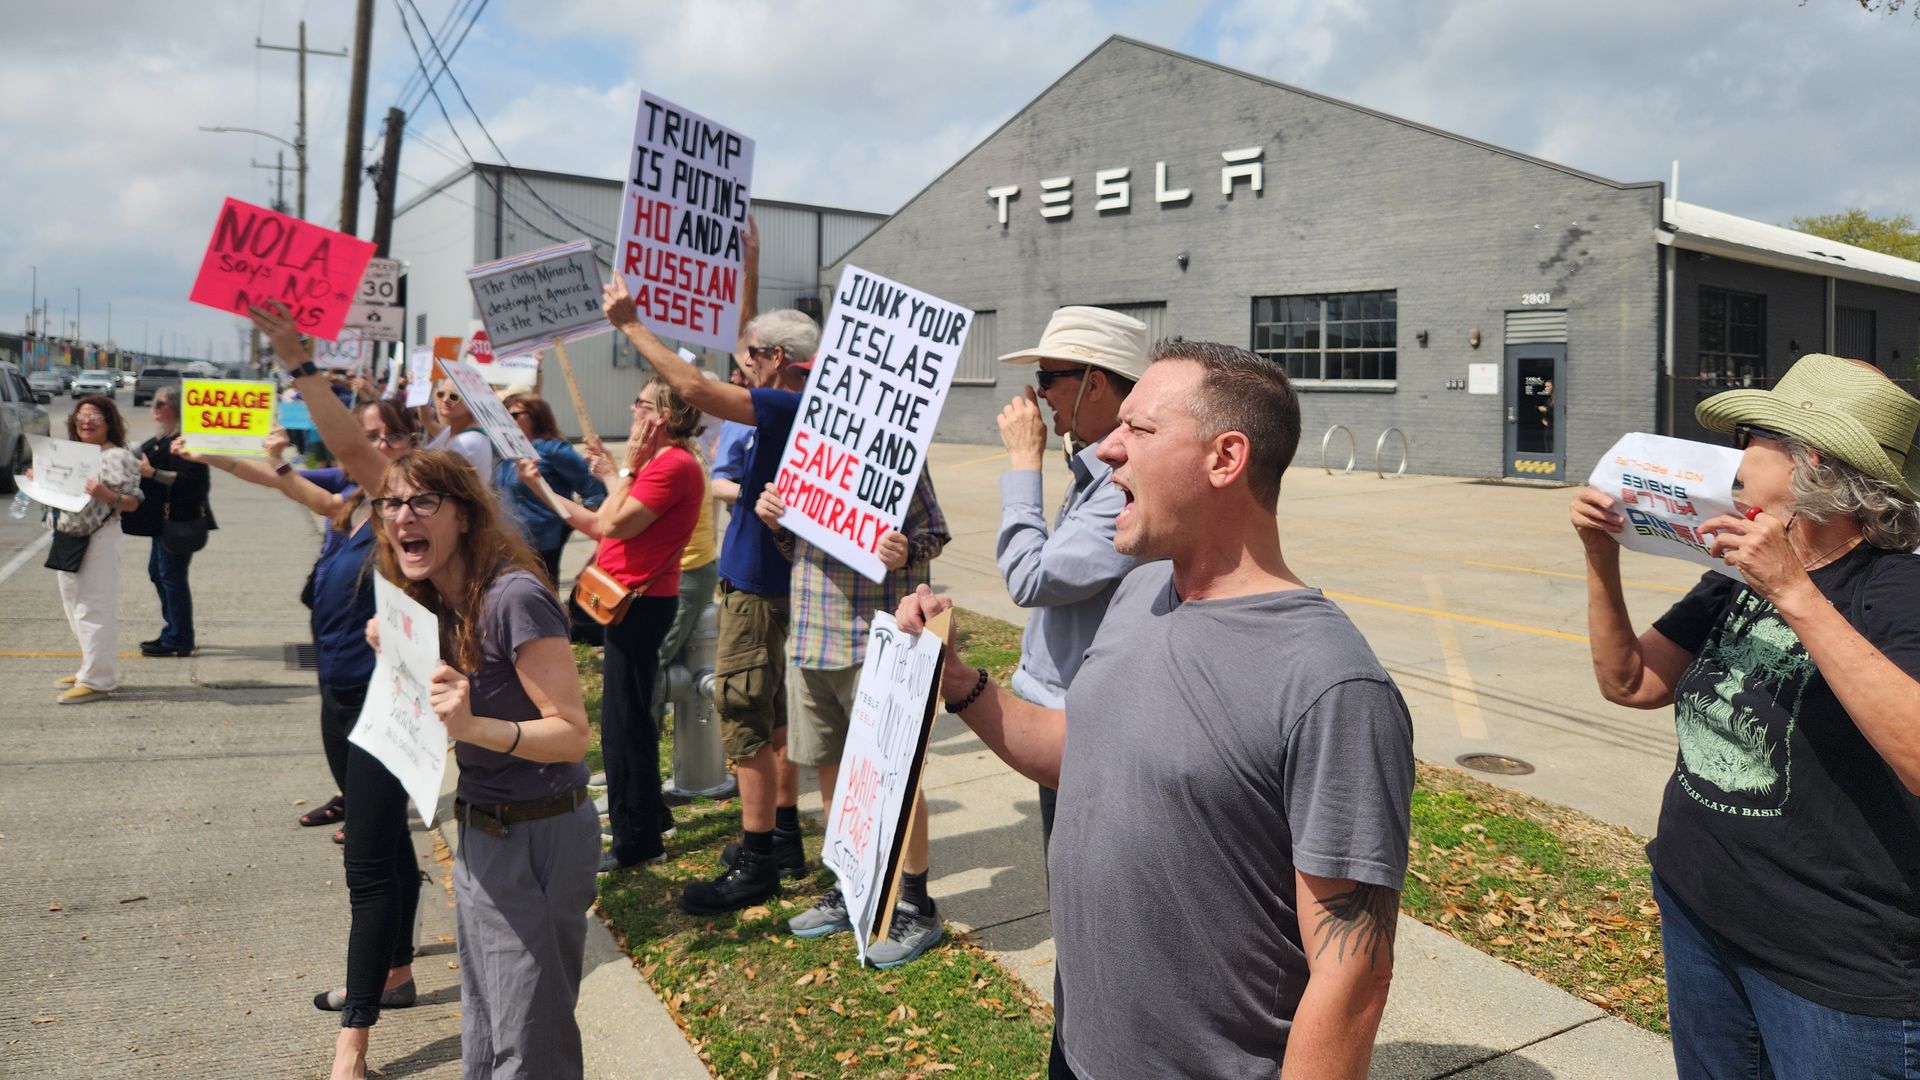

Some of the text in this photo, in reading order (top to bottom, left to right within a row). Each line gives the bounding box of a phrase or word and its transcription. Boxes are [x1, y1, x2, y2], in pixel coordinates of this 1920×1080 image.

[644, 99, 741, 170] TRUMP
[632, 145, 747, 224] IS PUTIN'S
[987, 146, 1263, 224] TESLA
[214, 205, 331, 277] NOLA
[675, 210, 722, 257] AND
[219, 253, 272, 284] says
[624, 240, 737, 305] RUSSIAN
[281, 273, 331, 301] NO
[363, 280, 393, 297] 30
[481, 279, 505, 295] The
[488, 282, 592, 317] destroying America
[1521, 292, 1550, 305] 2801
[511, 314, 532, 330] the
[540, 302, 579, 324] Rich
[635, 284, 724, 336] ASSET
[840, 274, 967, 346] JUNK YOUR
[472, 341, 492, 354] STO
[187, 389, 270, 409] GARAGE
[816, 354, 929, 433] EAT THE
[201, 411, 250, 430] SALE
[803, 395, 917, 475] RICH AND
[789, 432, 905, 516] SAVE OUR
[1622, 473, 1688, 499] BABIES
[1674, 469, 1704, 482] NOT
[1622, 488, 1698, 516] KILLS
[1742, 807, 1782, 816] BASIN
